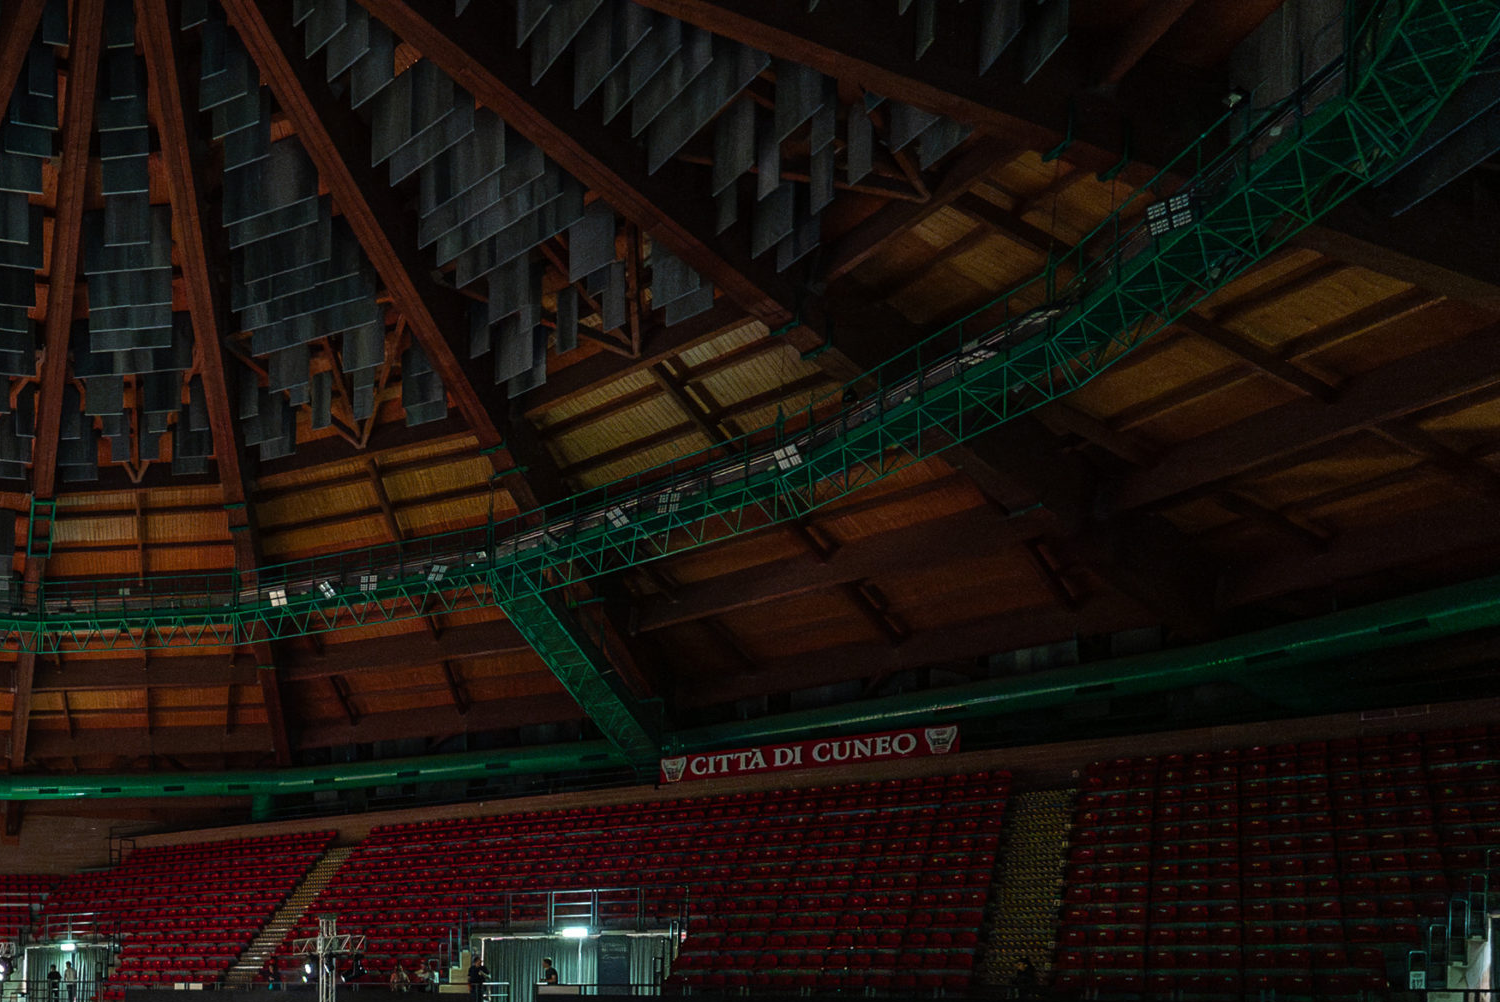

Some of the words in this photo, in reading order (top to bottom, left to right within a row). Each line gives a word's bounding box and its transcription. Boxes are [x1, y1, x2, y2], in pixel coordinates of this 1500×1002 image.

[690, 748, 767, 775] CITTÀ
[773, 746, 802, 768] DI
[812, 733, 917, 763] CUNEO
